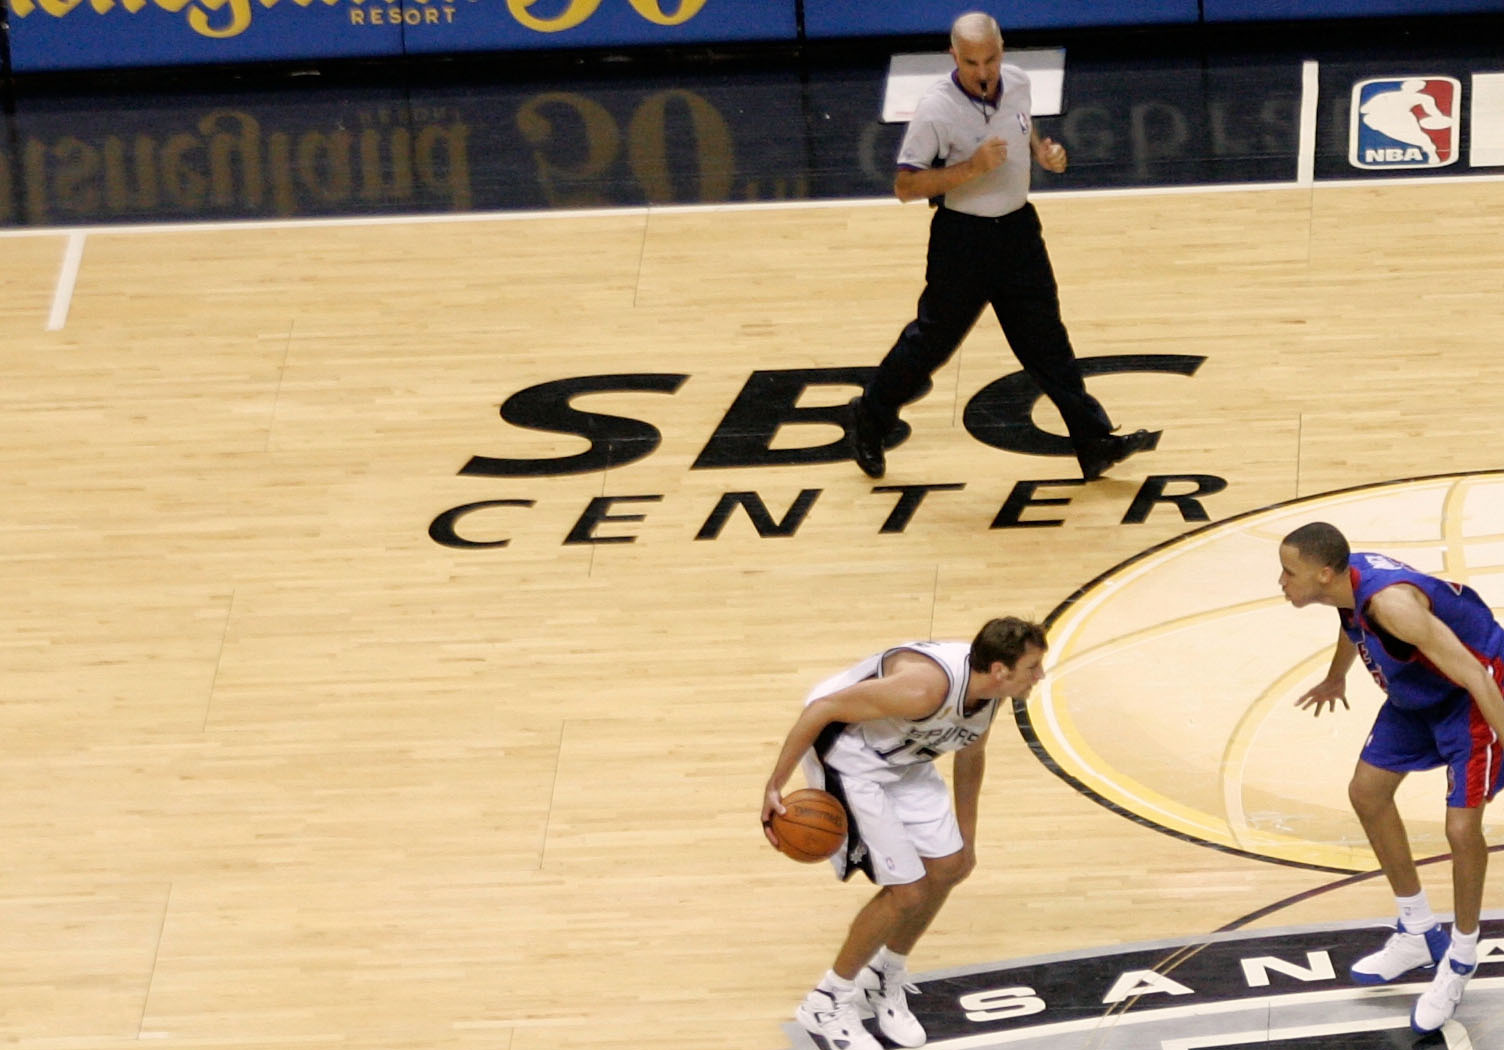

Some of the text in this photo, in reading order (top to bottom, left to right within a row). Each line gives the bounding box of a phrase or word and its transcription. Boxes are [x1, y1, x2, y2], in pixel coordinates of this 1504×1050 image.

[350, 7, 456, 25] RESORT
[1364, 147, 1424, 163] NBA
[457, 353, 1208, 478] SBC
[427, 473, 1229, 550] CENTER
[959, 950, 1336, 1022] SAN
